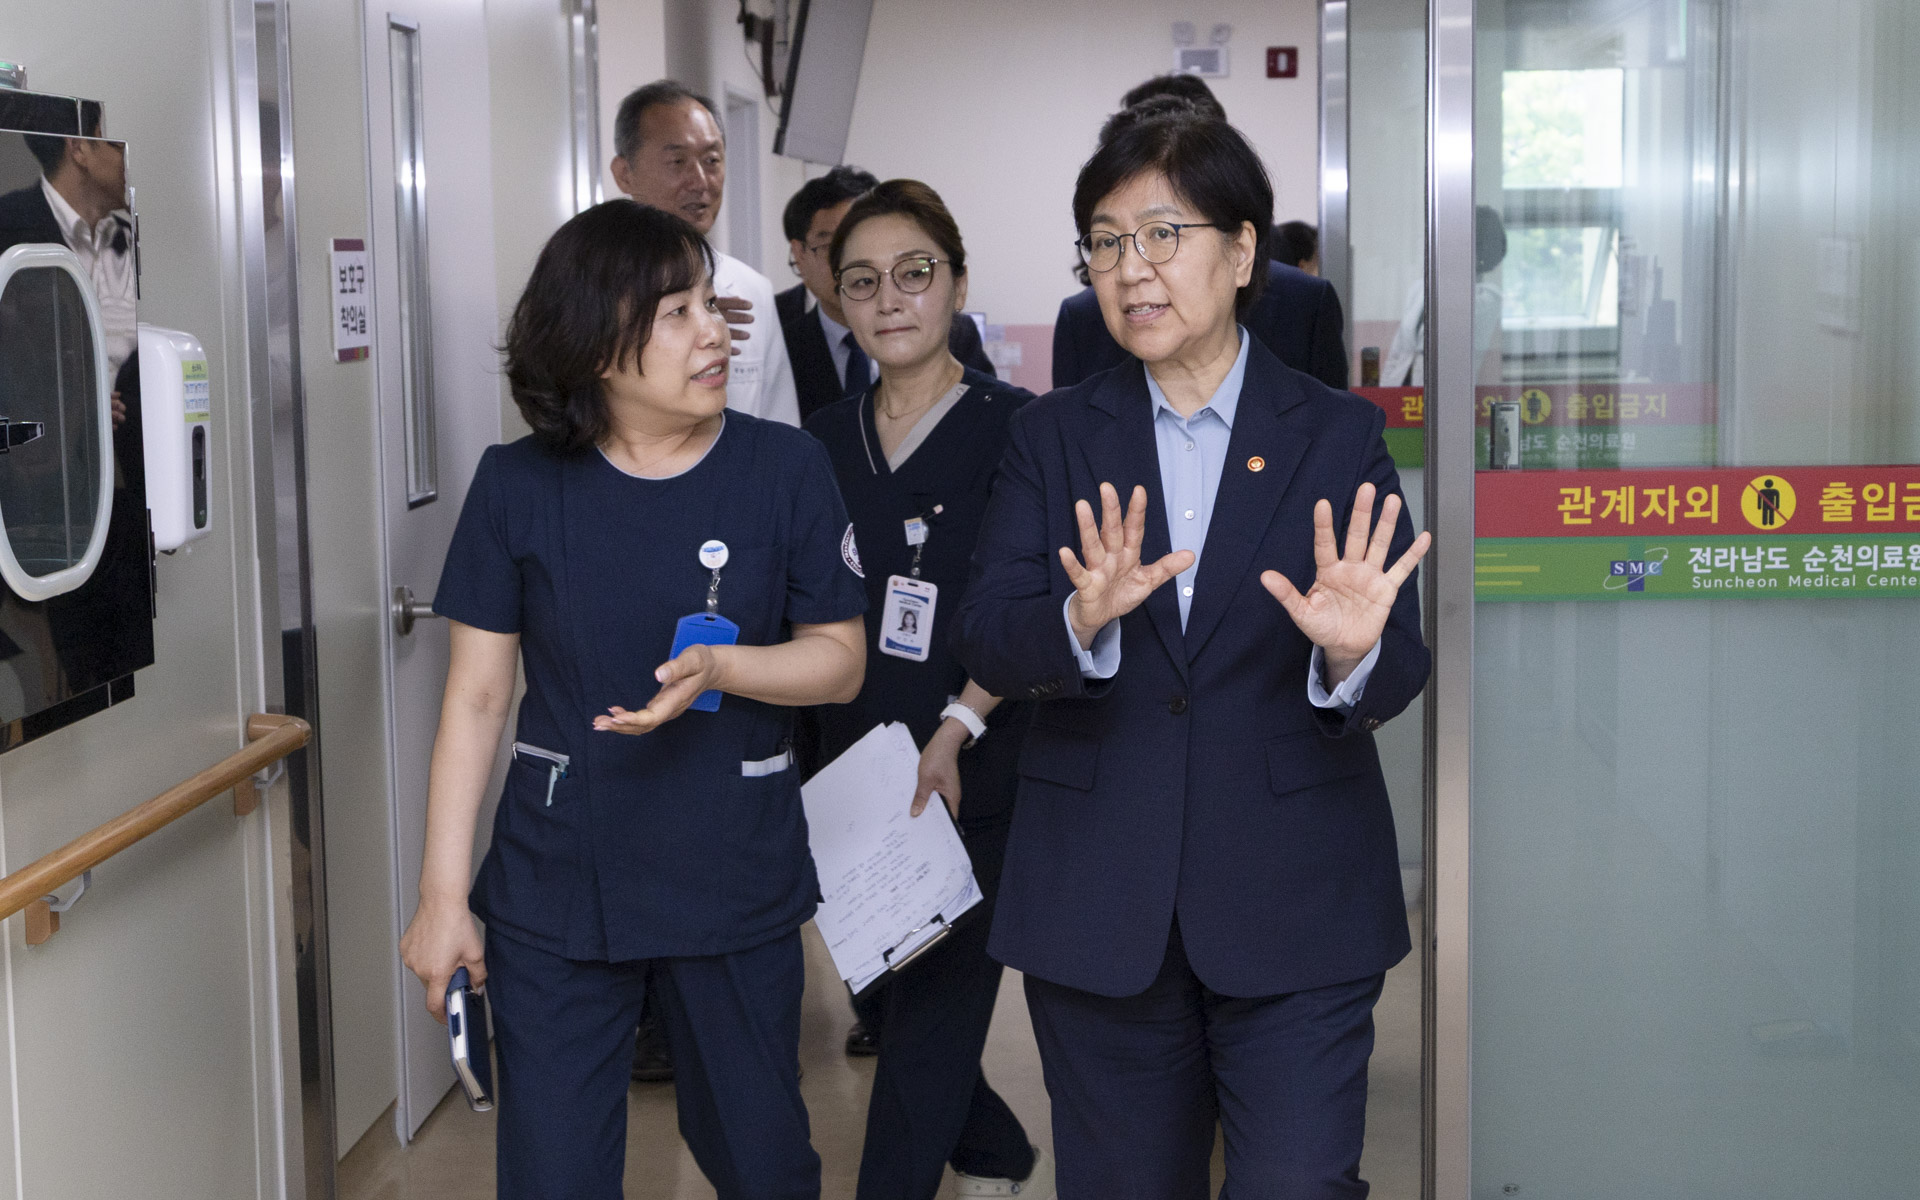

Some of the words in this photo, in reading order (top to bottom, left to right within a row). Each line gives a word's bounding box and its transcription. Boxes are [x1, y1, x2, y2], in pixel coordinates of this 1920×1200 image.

[339, 264, 365, 294] 보호구
[340, 305, 367, 336] 착의실
[1565, 392, 1667, 419] 출입금지
[1557, 484, 1719, 525] 관계자외
[1613, 561, 1661, 575] SMC
[1687, 545, 1790, 574] 전라남도
[1692, 575, 1778, 589] Suncheon
[1788, 574, 1856, 588] Medical
[1866, 573, 1920, 587] Cente
